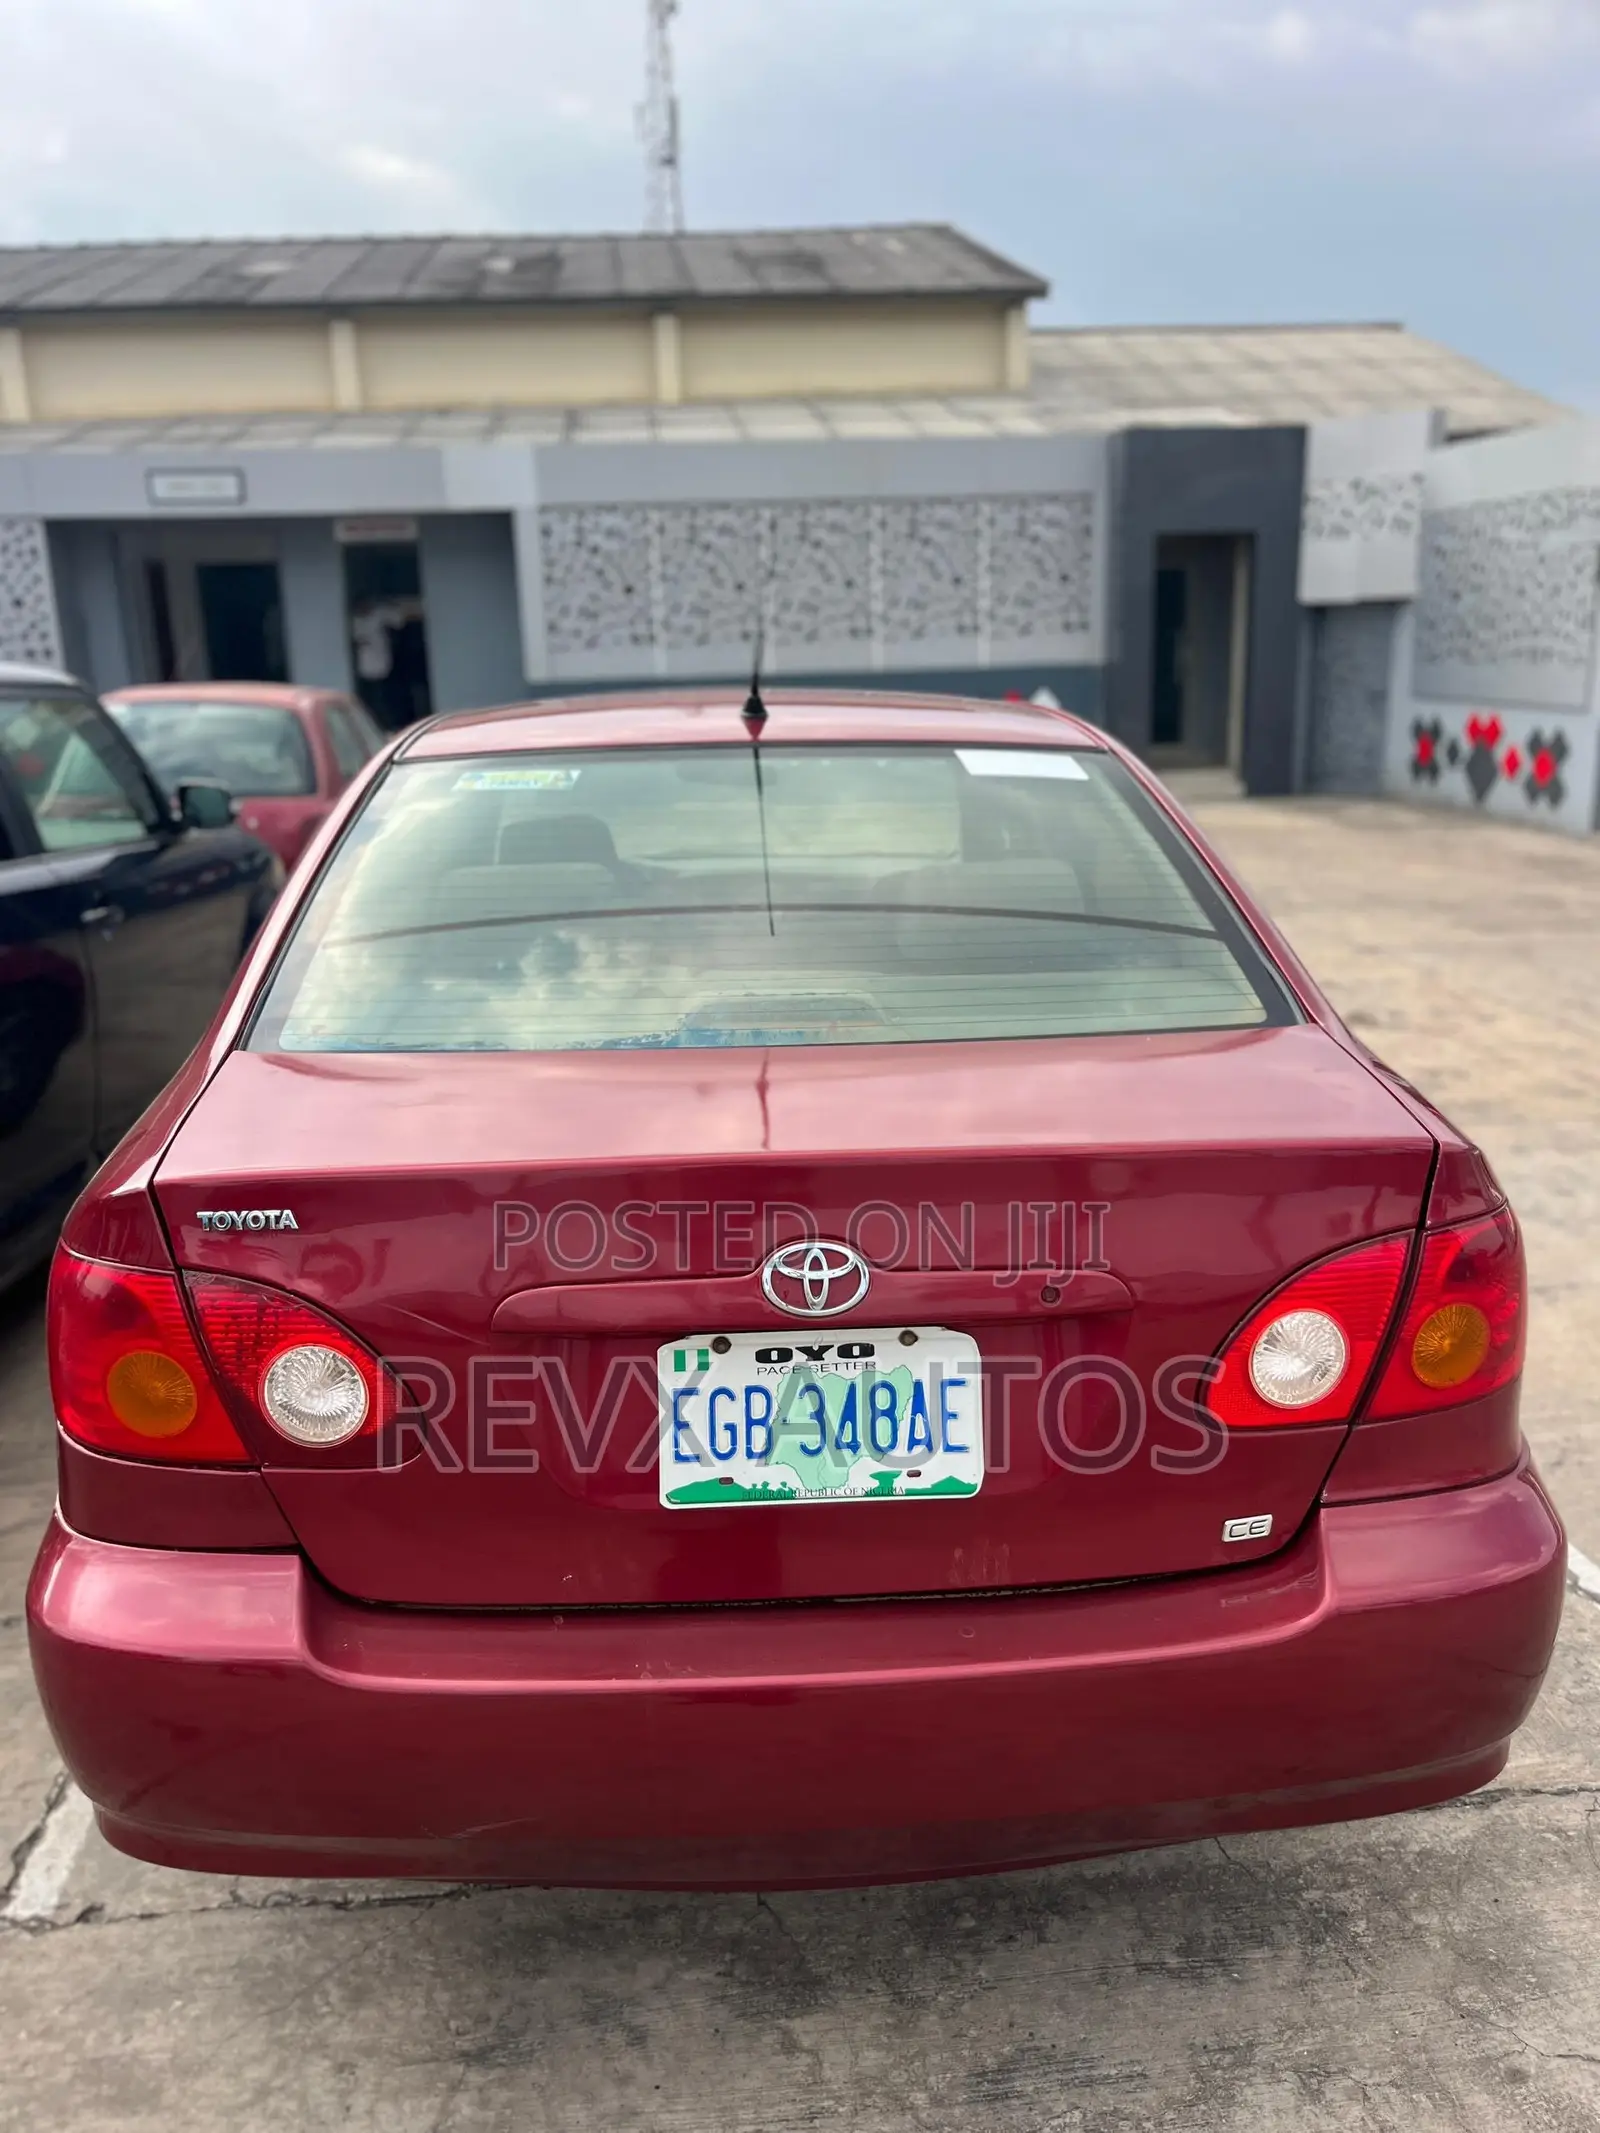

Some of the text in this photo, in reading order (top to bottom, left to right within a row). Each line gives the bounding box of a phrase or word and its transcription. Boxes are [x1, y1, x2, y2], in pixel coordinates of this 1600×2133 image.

[196, 1209, 299, 1231] TOYOTA
[755, 1342, 875, 1364] OYO
[757, 1361, 877, 1376] PACE SETTER
[843, 1486, 858, 1496] OF
[1228, 1518, 1269, 1538] CE
